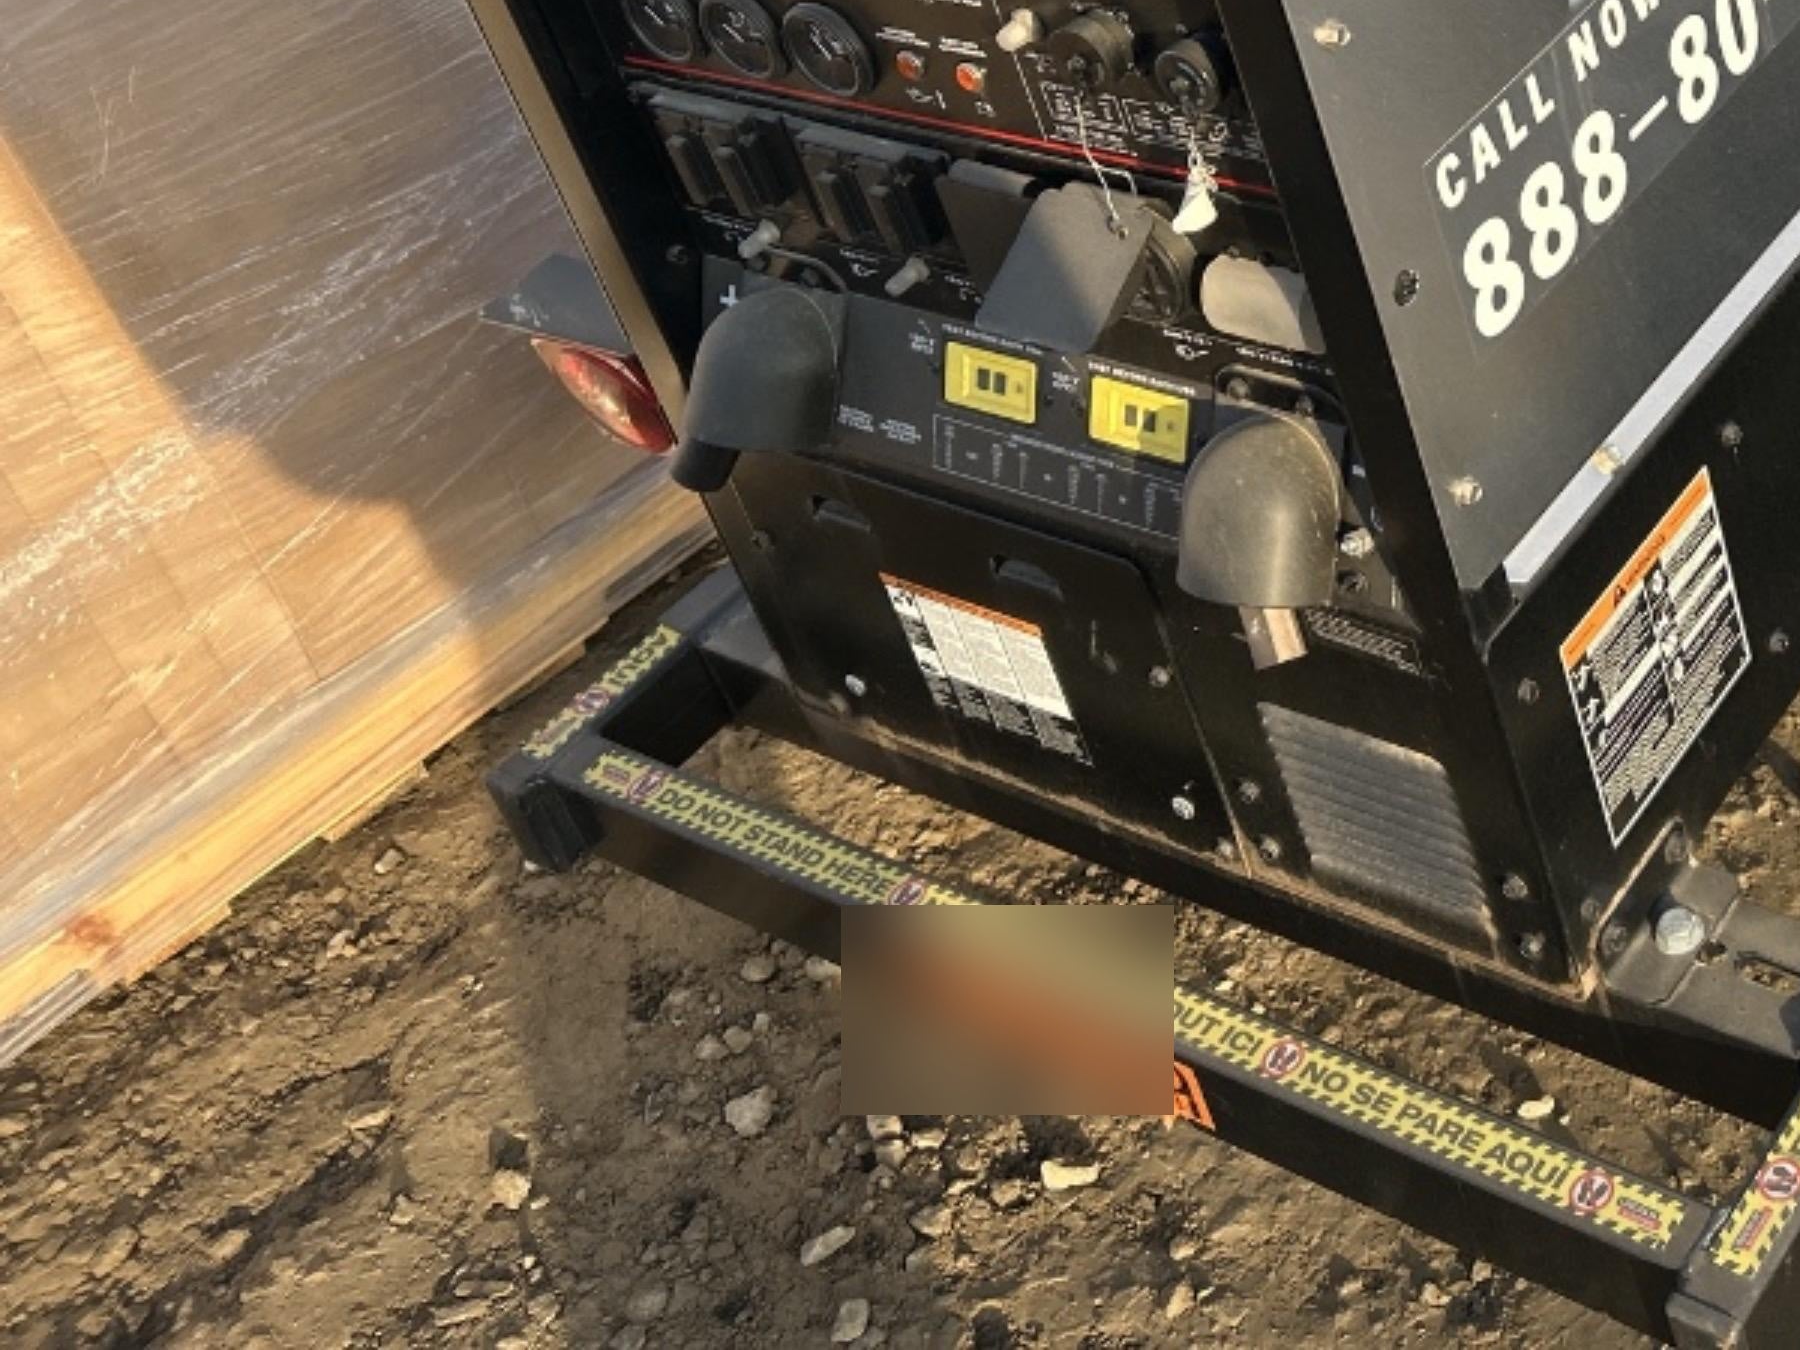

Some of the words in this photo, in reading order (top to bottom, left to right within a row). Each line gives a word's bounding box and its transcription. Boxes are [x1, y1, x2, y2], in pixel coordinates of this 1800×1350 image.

[1434, 73, 1555, 210] CALL
[656, 786, 697, 817] DO
[697, 804, 742, 843] NOT
[743, 822, 827, 880] STAND
[826, 852, 899, 897] HERE
[1218, 1024, 1262, 1058] ICI
[1303, 1060, 1349, 1095] NO
[1353, 1080, 1399, 1113] SE
[1395, 1100, 1485, 1154] PARE
